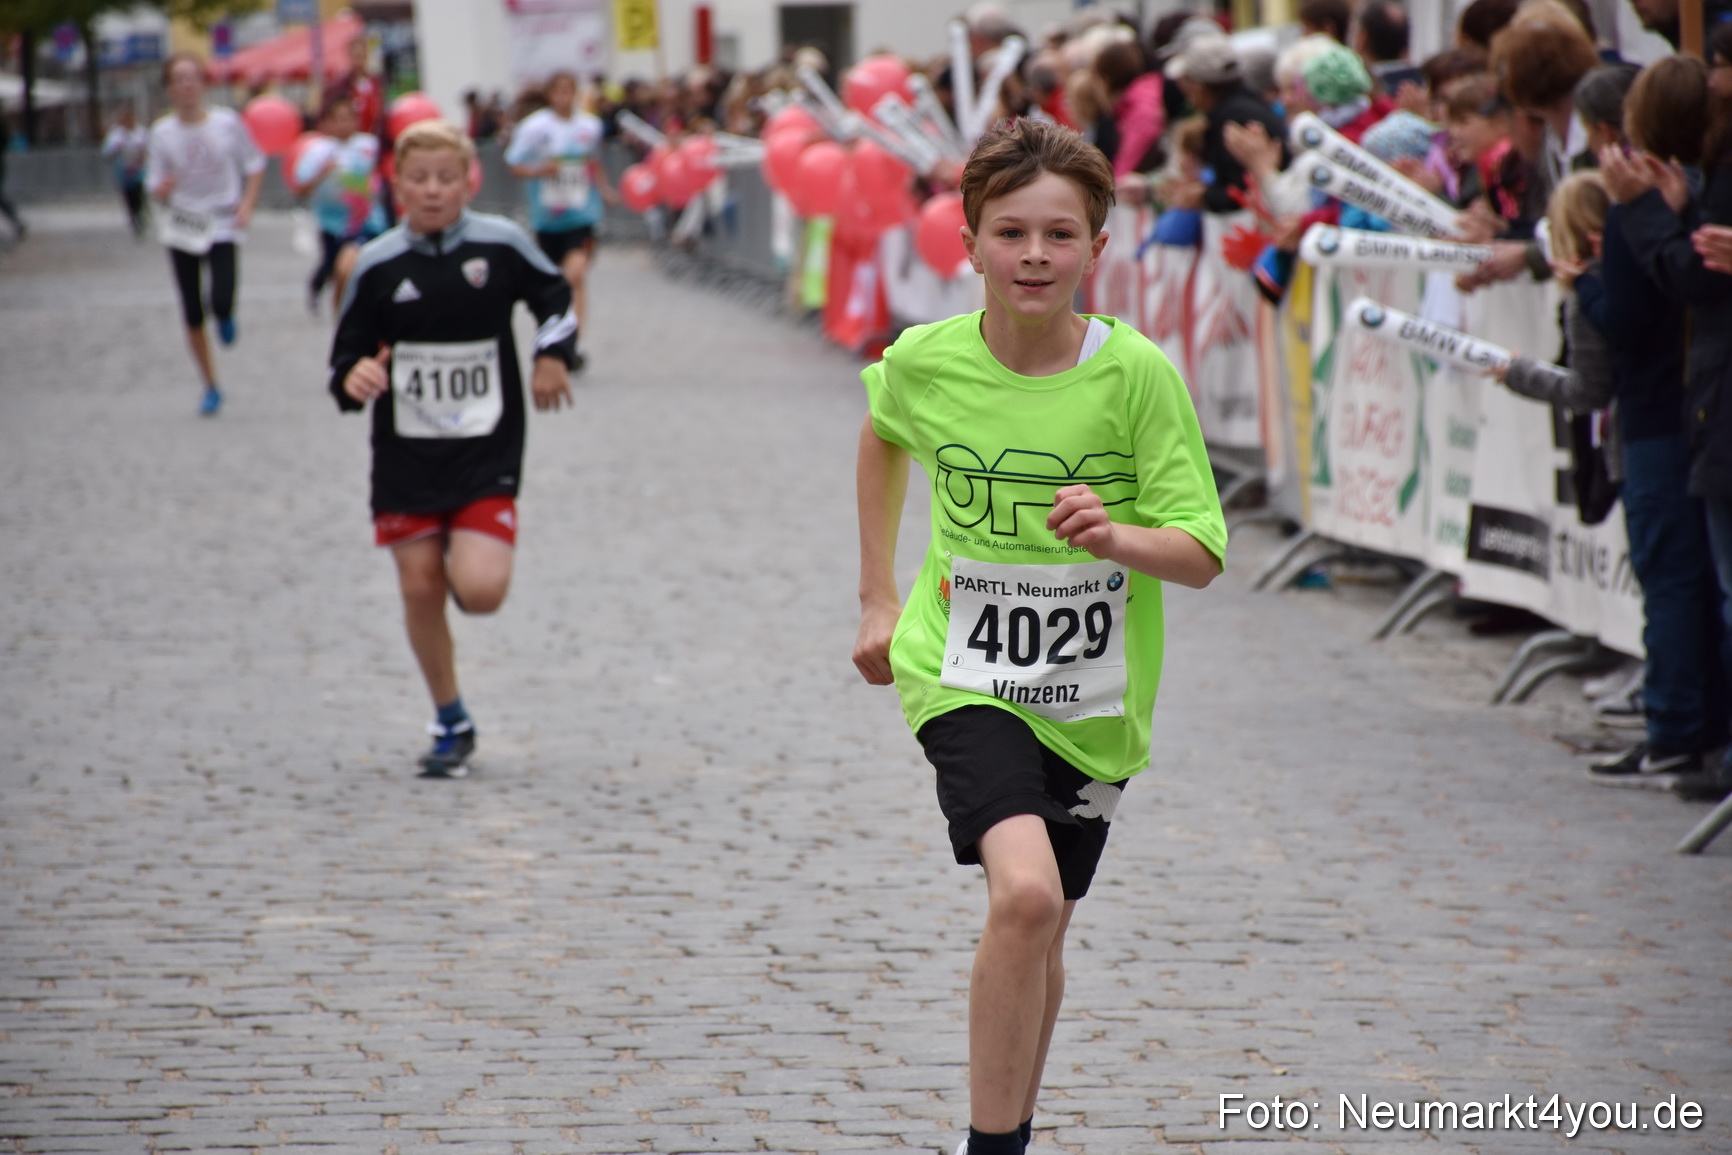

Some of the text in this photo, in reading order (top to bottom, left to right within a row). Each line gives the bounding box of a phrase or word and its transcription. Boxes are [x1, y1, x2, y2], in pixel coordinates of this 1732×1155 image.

[1355, 240, 1410, 259] BMW
[1399, 320, 1457, 356] BMW
[406, 364, 489, 402] 4100
[939, 524, 1088, 556] ebäude- und Automatisierungste
[954, 574, 1100, 598] PARTL Neumarkt
[966, 601, 1112, 668] 4029
[992, 678, 1080, 704] Vinzenz
